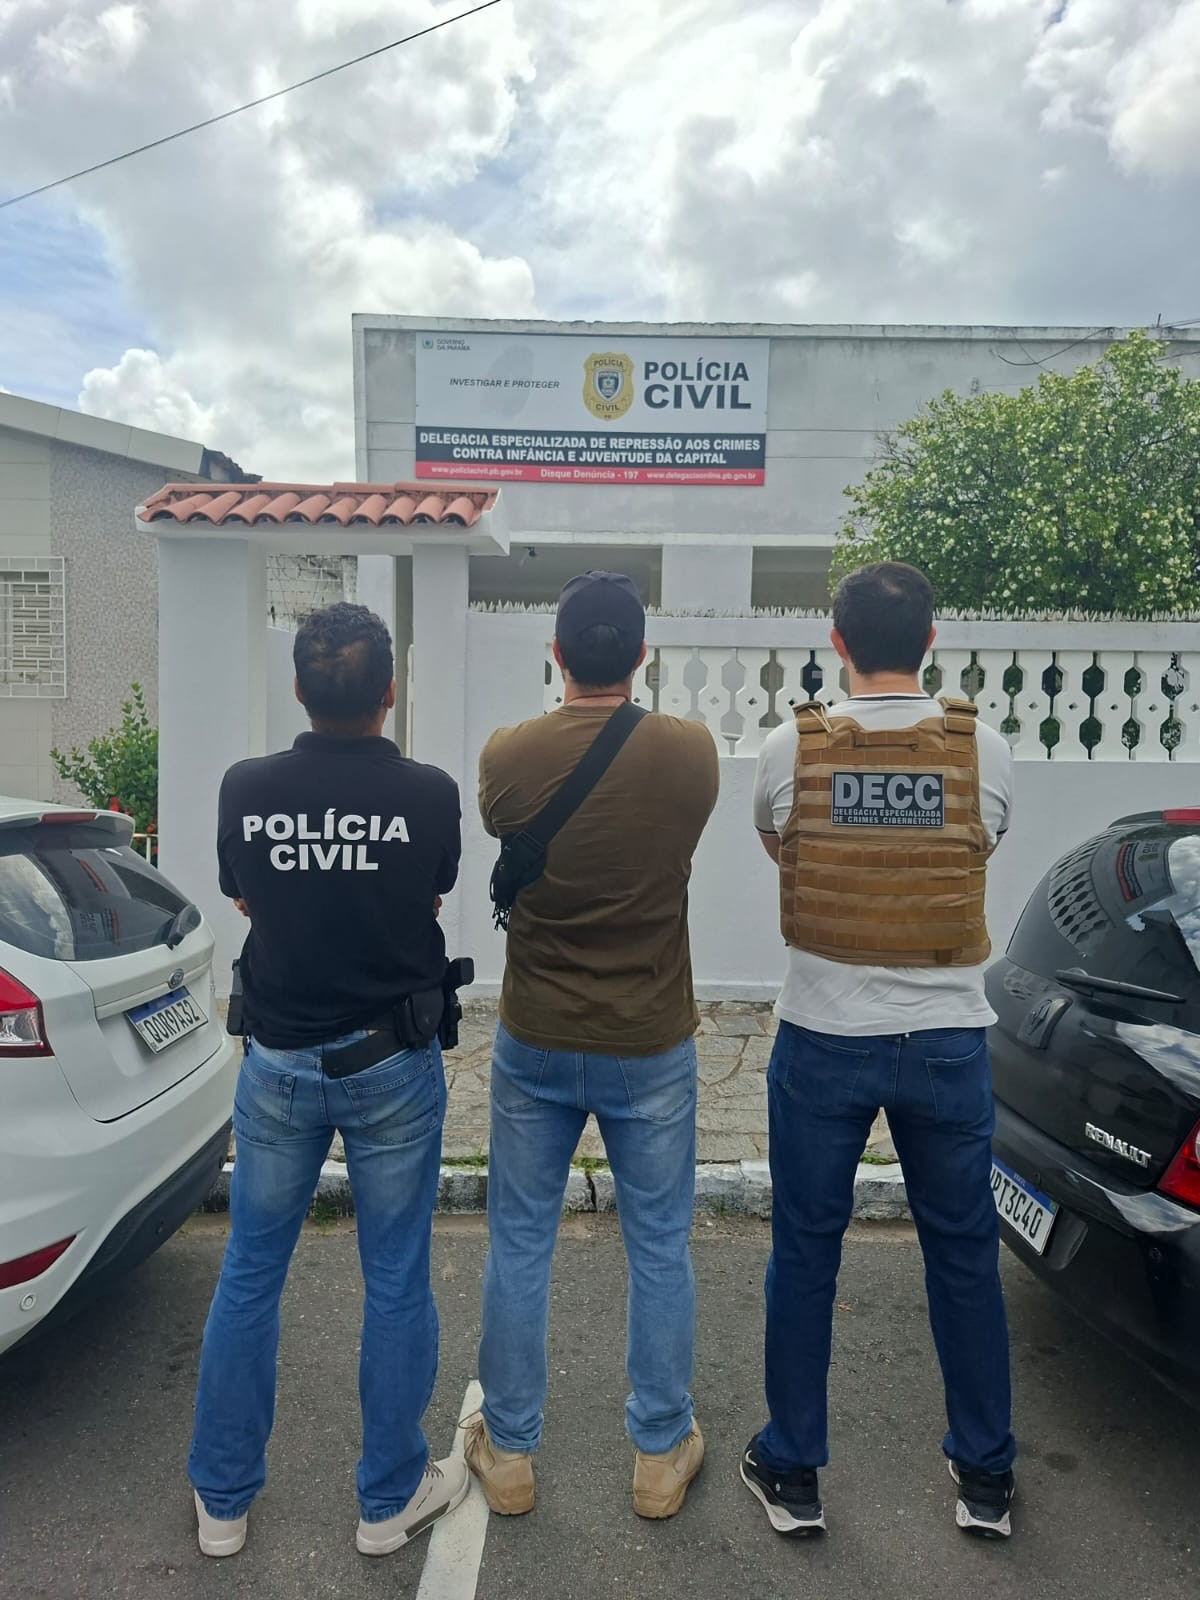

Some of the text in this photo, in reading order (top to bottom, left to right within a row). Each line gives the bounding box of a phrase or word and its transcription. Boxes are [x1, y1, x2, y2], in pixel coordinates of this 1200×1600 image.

[593, 357, 624, 369] POLÍCIA
[644, 357, 749, 381] POLÍCIA
[449, 378, 560, 389] INVESTIGAR E PROTEGER
[644, 384, 752, 410] CIVIL
[595, 403, 620, 412] CIVIL
[420, 432, 761, 451] DELEGACIA ESPECIALIZADA DE REPRESSÃO AOS CRIMES
[453, 447, 727, 464] CONTRA INFÂNCIA E JUVENTUDE DA CAPITAL
[540, 468, 571, 479] Disque
[573, 470, 615, 479] Denúncia
[624, 471, 639, 480] 197
[834, 775, 940, 809] DECC
[243, 808, 410, 842] POLÍCIA
[847, 816, 879, 824] CRIMES
[269, 844, 379, 871] CIVIL
[1085, 1122, 1152, 1168] RENAULT
